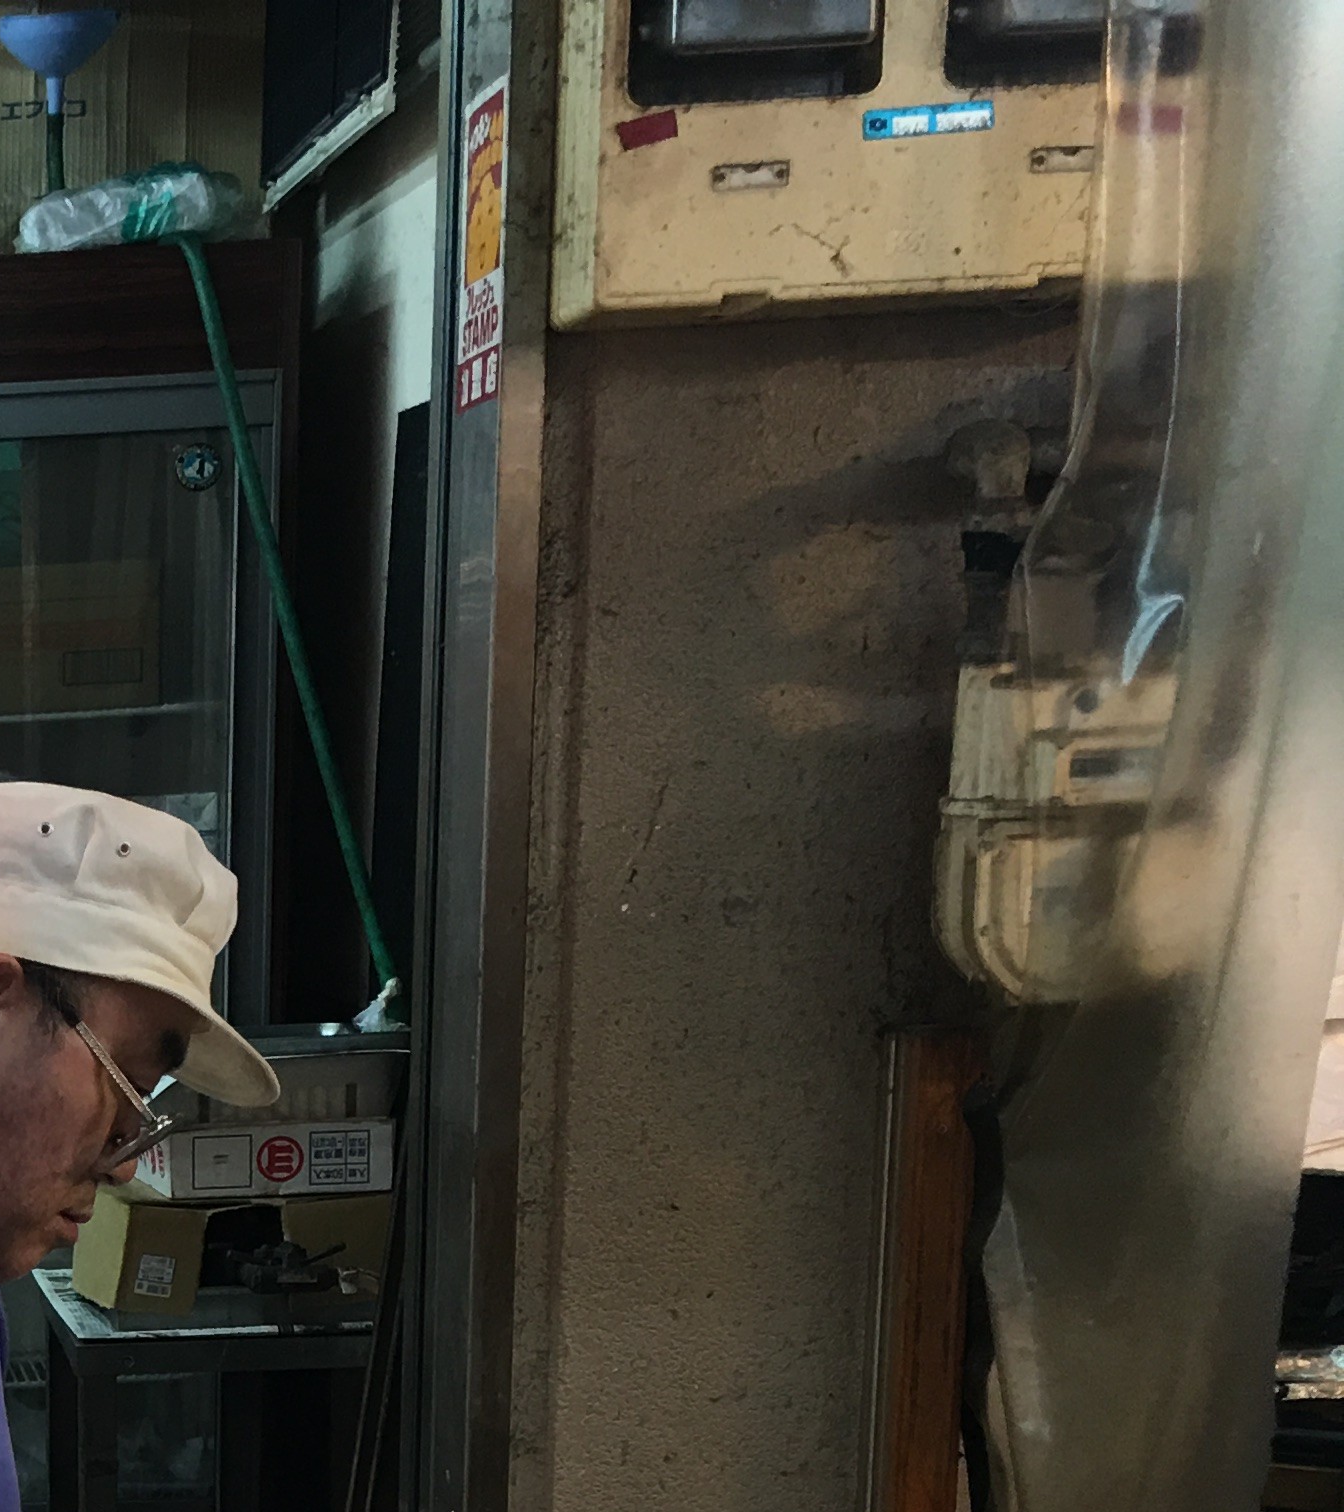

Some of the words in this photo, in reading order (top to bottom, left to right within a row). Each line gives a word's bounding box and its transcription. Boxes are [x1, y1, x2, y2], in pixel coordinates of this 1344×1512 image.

[0, 101, 87, 121] エフコ
[462, 313, 499, 357] STAMP
